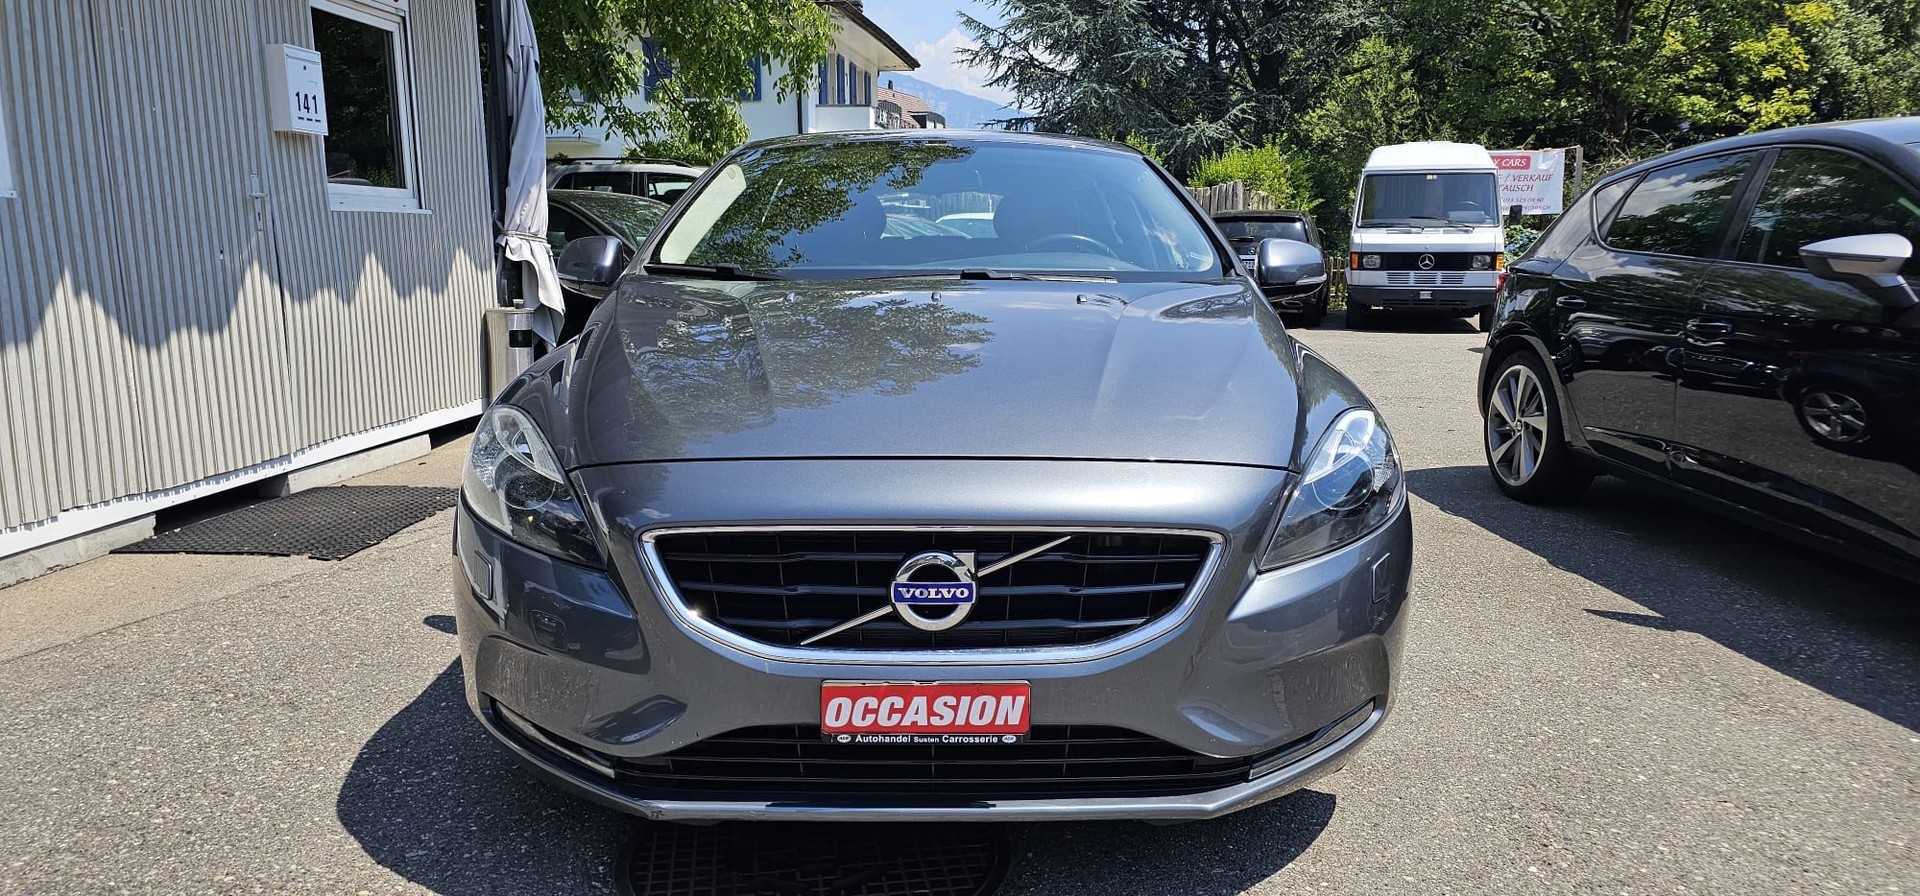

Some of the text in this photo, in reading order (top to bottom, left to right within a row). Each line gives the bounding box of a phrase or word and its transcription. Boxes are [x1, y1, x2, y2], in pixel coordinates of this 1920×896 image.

[295, 91, 318, 114] 141
[1502, 158, 1528, 167] CARS
[1512, 174, 1554, 182] VERKAUF
[898, 587, 969, 598] VOLVO
[824, 694, 1026, 727] OCCASION
[855, 734, 911, 743] Autohandel
[942, 734, 998, 743] Carrosserie
